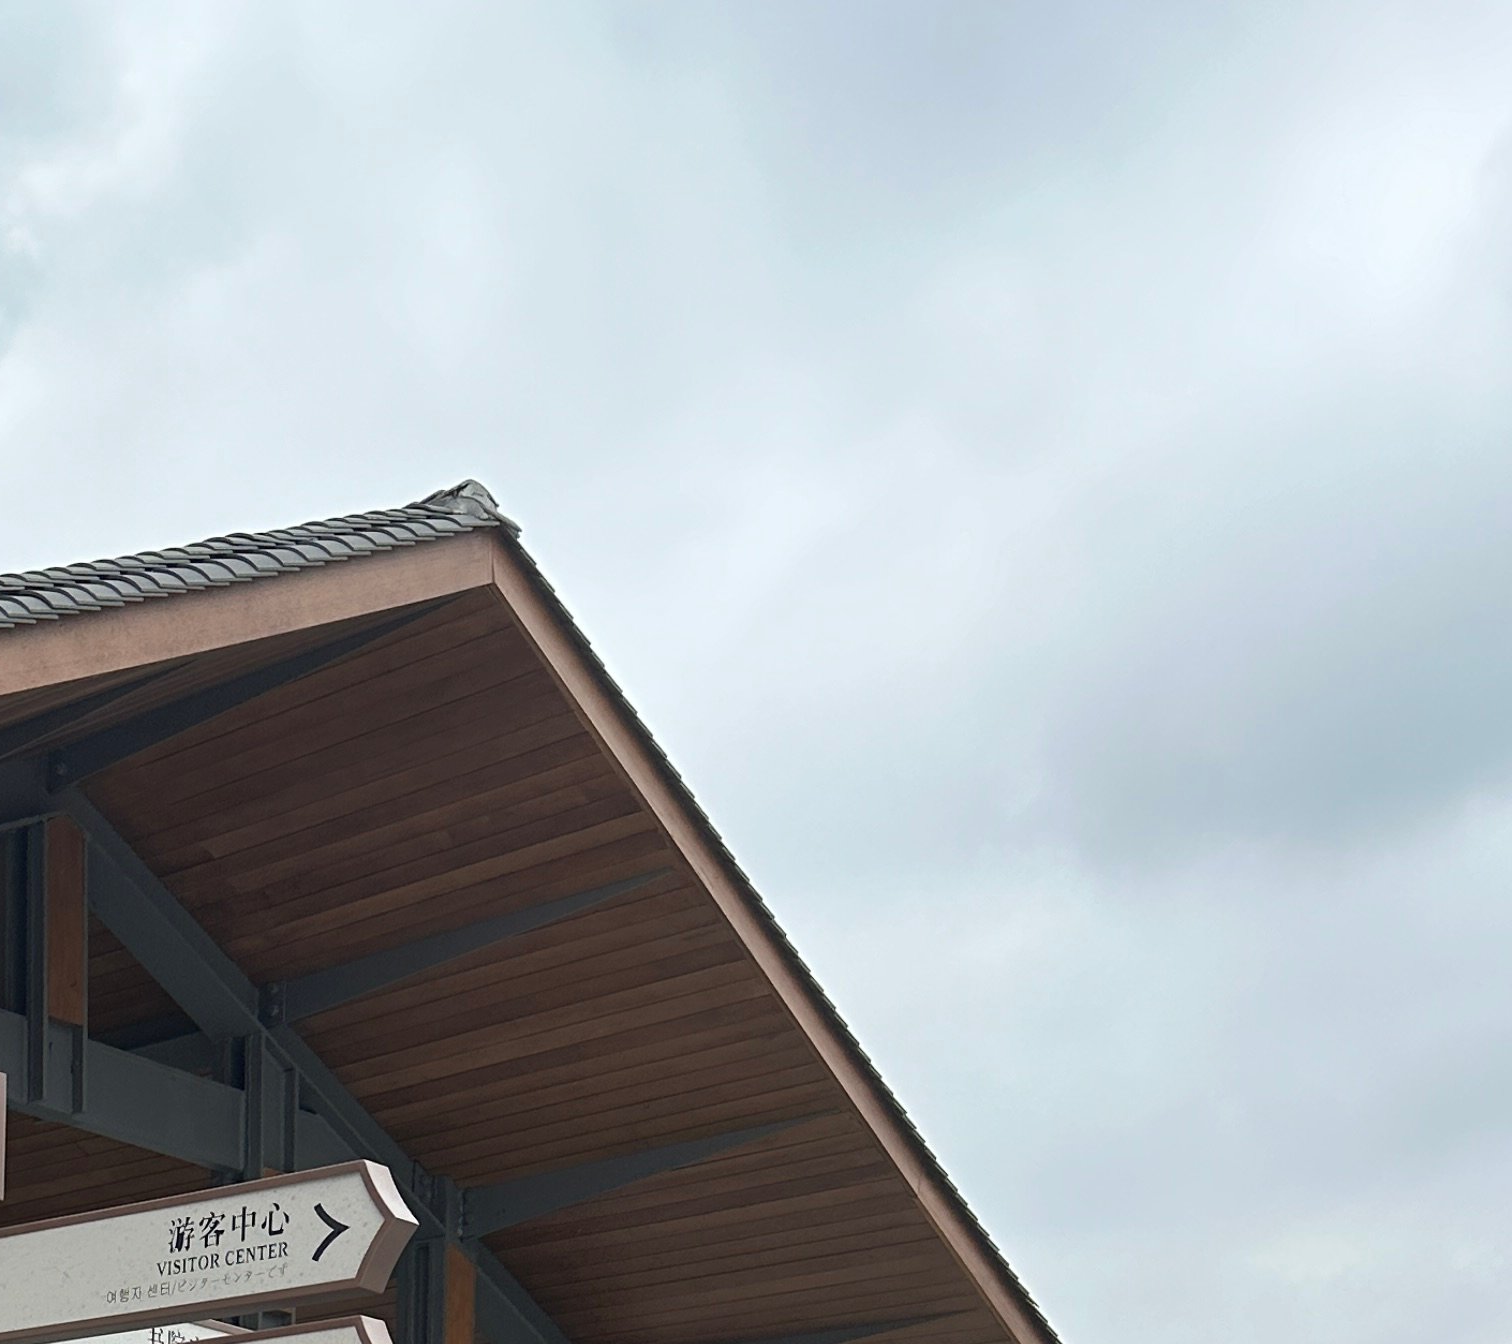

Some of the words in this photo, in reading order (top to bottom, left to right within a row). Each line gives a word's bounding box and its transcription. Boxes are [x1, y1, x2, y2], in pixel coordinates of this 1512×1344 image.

[167, 1202, 290, 1254] 游客中心
[156, 1253, 221, 1277] VISITOR
[225, 1241, 289, 1267] CENTER
